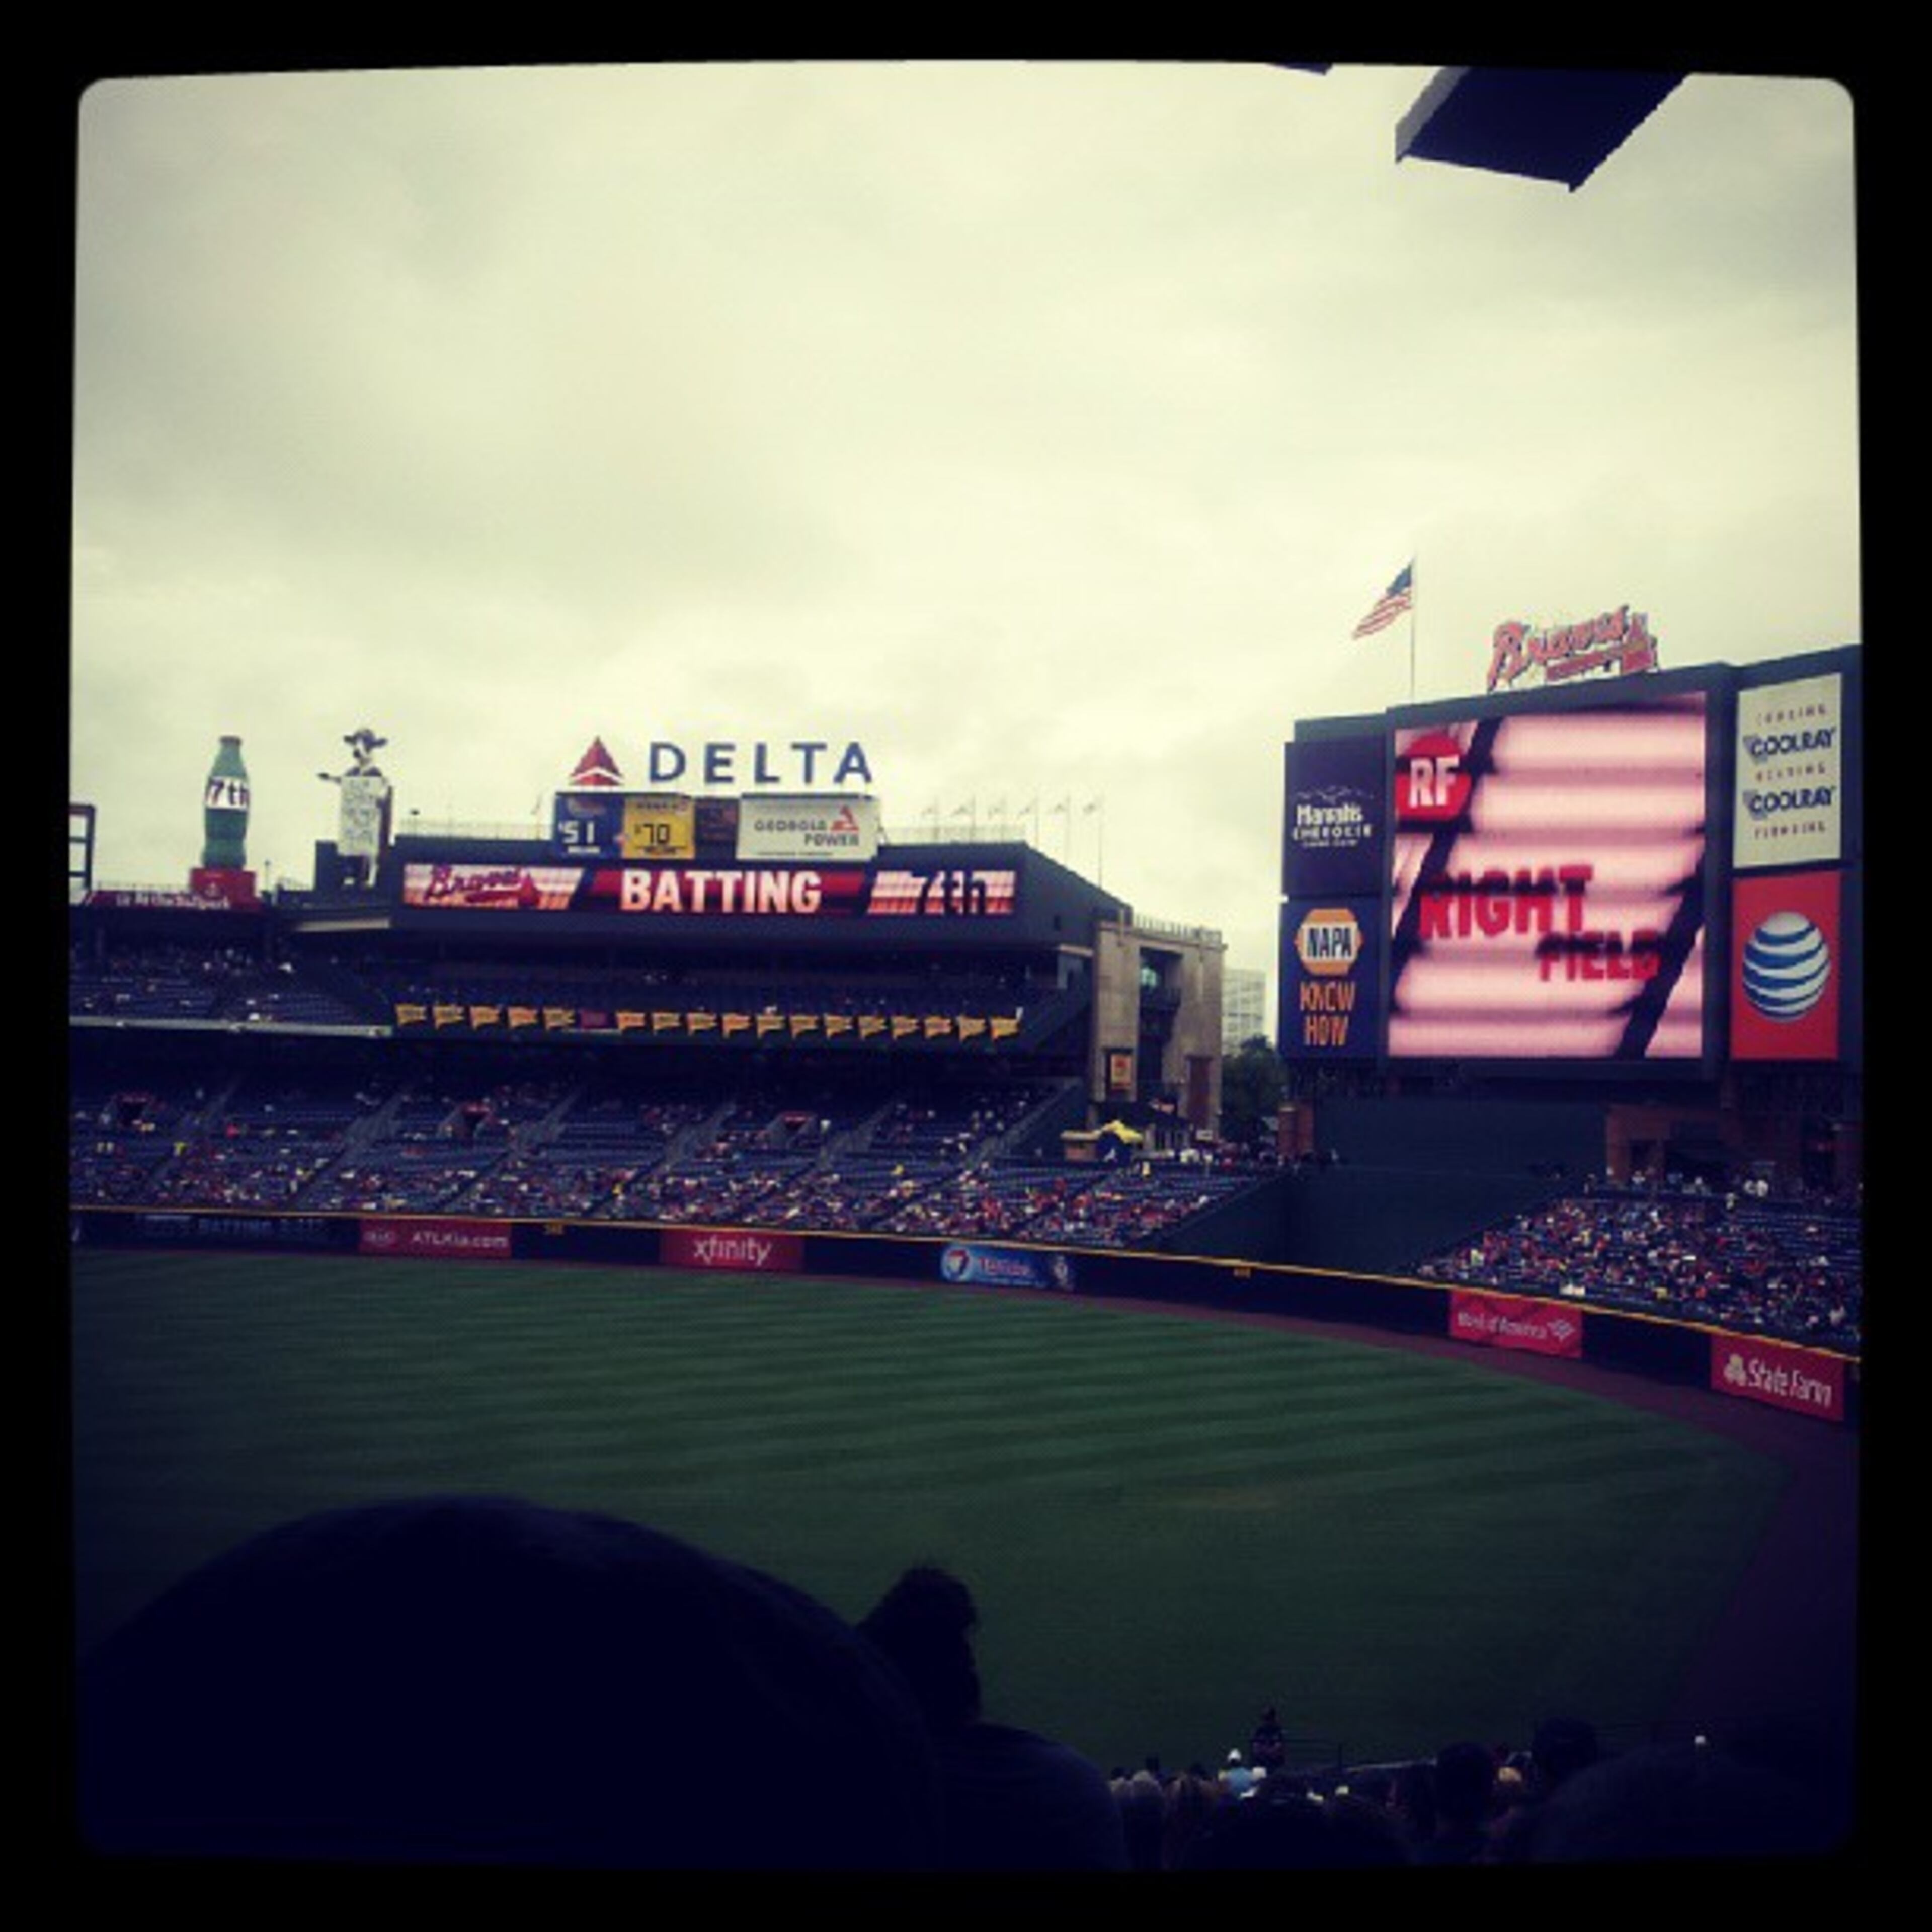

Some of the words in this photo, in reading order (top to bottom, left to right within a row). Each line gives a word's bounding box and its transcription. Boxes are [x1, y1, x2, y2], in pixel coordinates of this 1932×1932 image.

[1750, 728, 1835, 756] COOLRAY
[649, 742, 873, 784] DELTA
[207, 779, 250, 807] 7th
[1410, 755, 1460, 808] RF
[1749, 786, 1835, 814] COOLRAY
[804, 833, 859, 847] POWER
[619, 869, 822, 914] BATTING
[1420, 865, 1592, 940] RIGHT
[1309, 927, 1352, 958] NAPA
[1535, 929, 1660, 982] FIELD
[1300, 981, 1356, 1011] KNOW
[1304, 1014, 1349, 1046] HOW
[692, 1235, 771, 1267] xfinity
[1748, 1358, 1789, 1393] State
[1790, 1369, 1832, 1407] Farm
